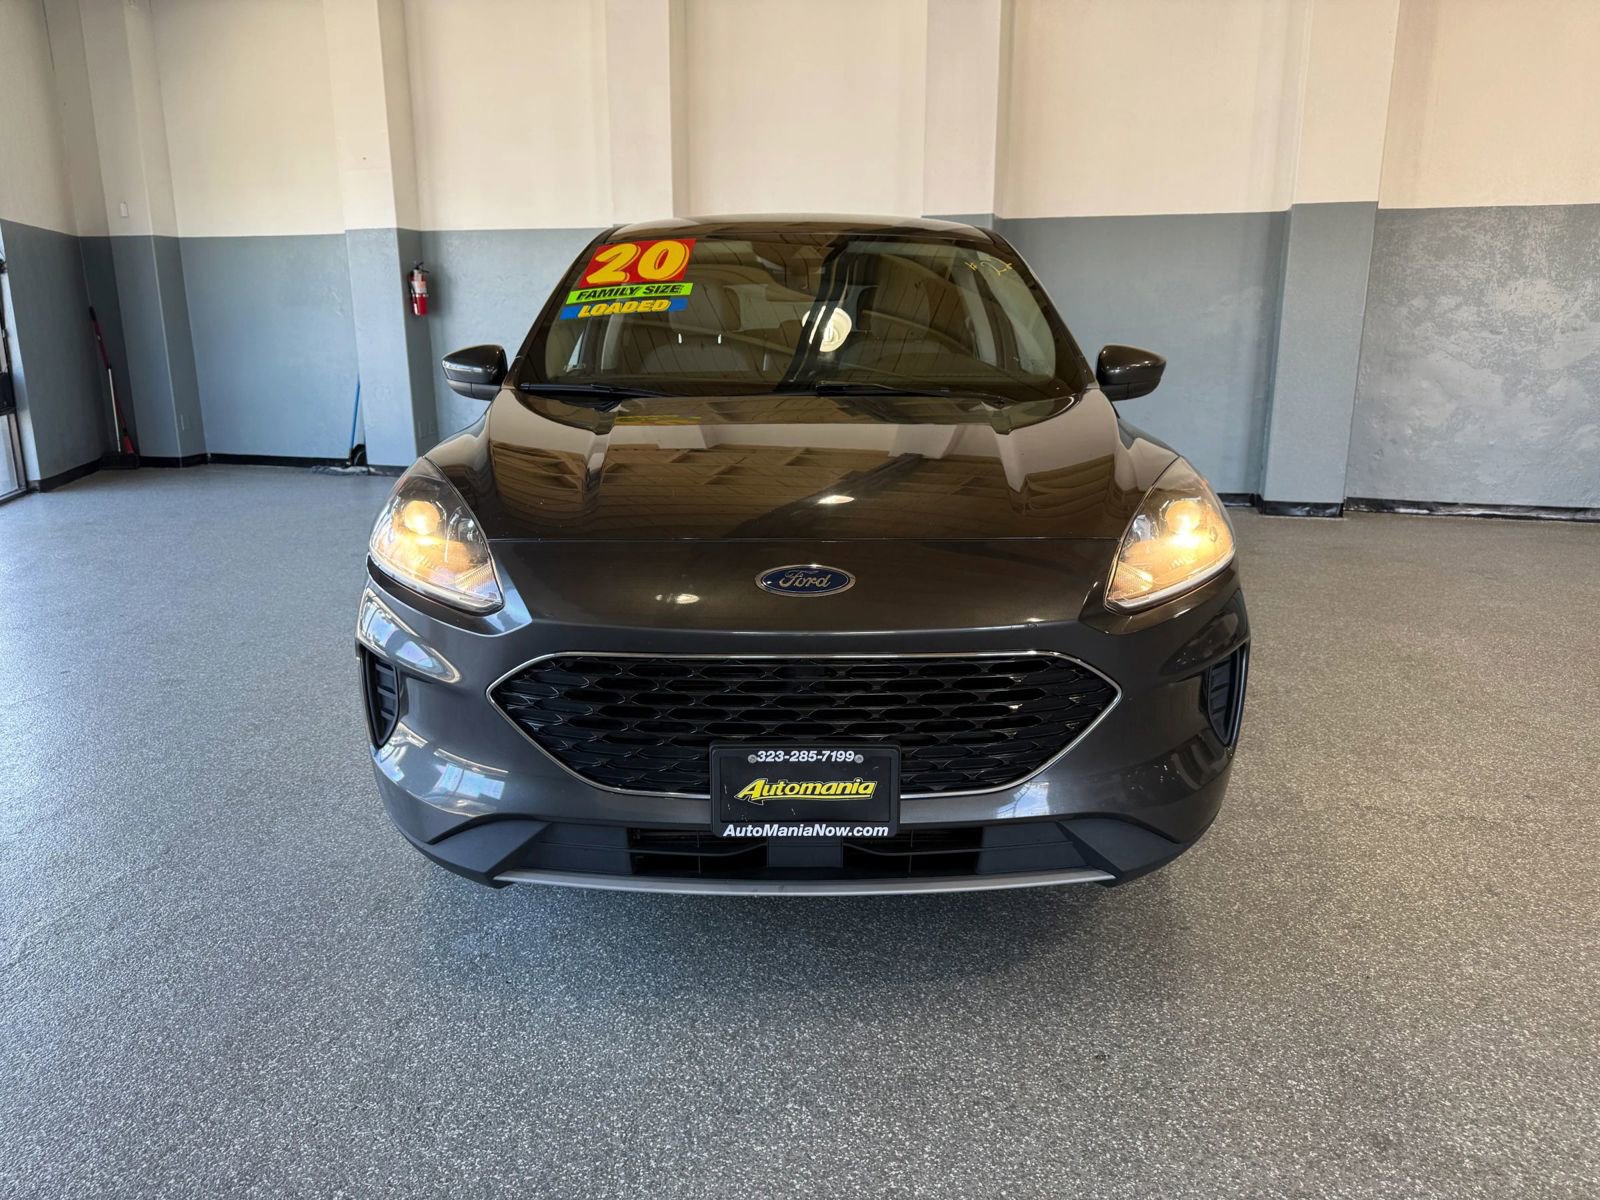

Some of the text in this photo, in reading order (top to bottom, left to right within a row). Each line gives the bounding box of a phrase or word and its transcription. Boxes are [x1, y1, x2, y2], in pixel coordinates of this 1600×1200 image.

[586, 240, 690, 284] 20
[576, 284, 682, 301] FAMILY SIZE
[578, 299, 671, 319] LOADED
[779, 570, 831, 588] Ford
[756, 750, 855, 762] 323-285-7199
[736, 778, 877, 801] Automania
[723, 823, 888, 837] AutoManiaNow.com
